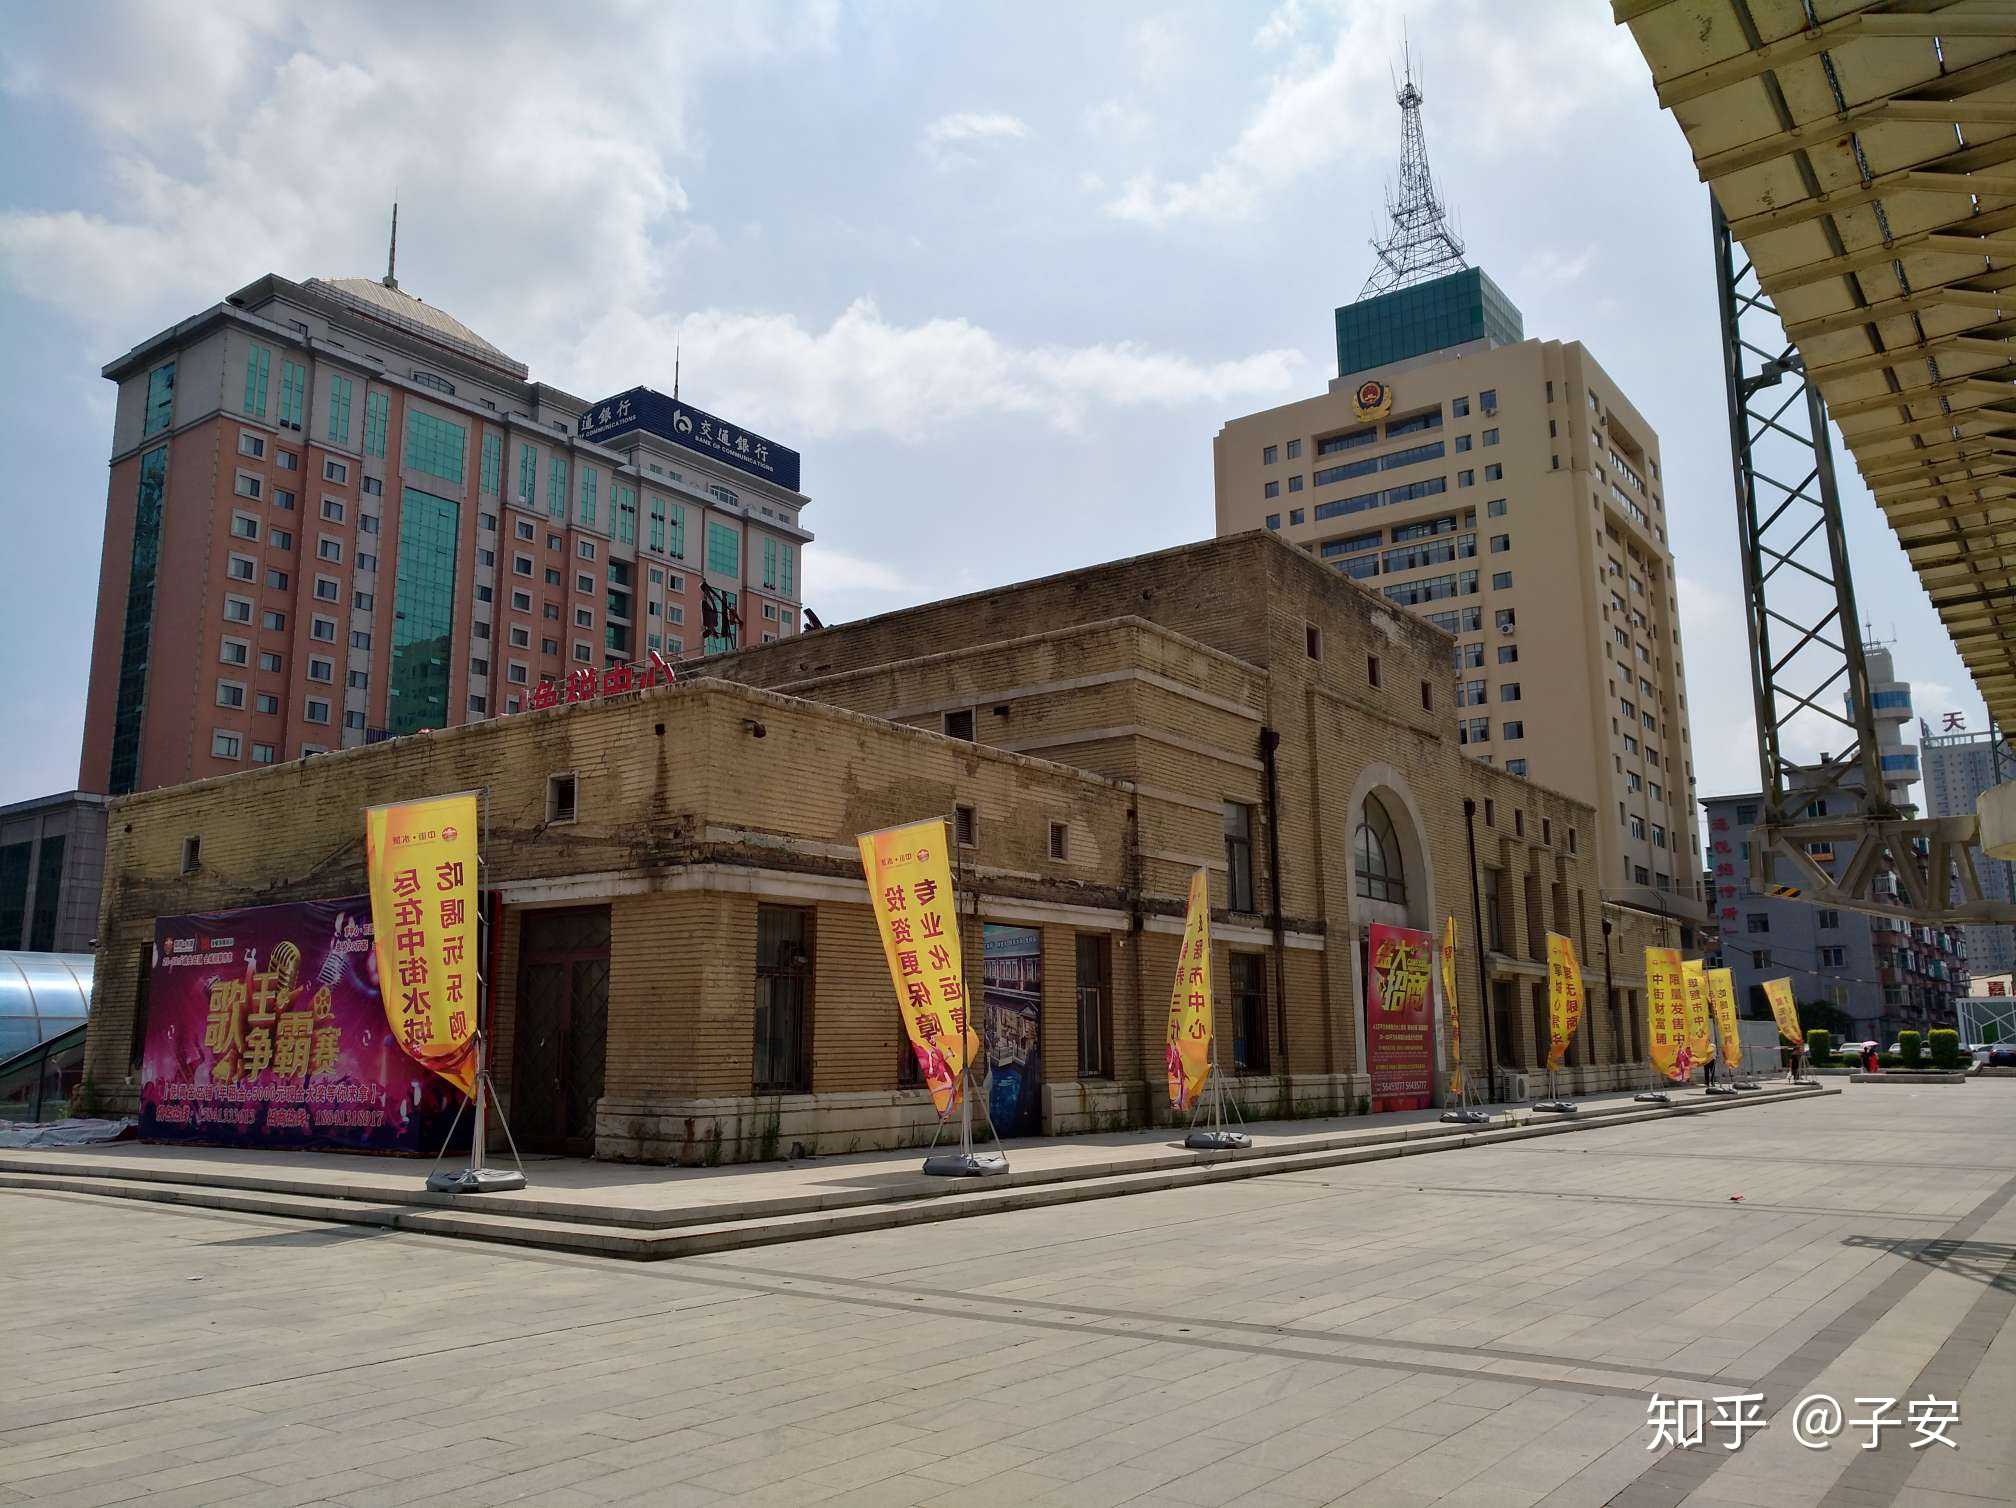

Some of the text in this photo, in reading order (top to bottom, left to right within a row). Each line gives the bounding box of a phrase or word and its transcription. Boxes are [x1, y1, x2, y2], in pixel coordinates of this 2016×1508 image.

[695, 435, 712, 447] BANK
[722, 447, 774, 472] COMMUNICATIONS
[700, 420, 769, 462] 交通銀行
[1942, 711, 1966, 732] 天
